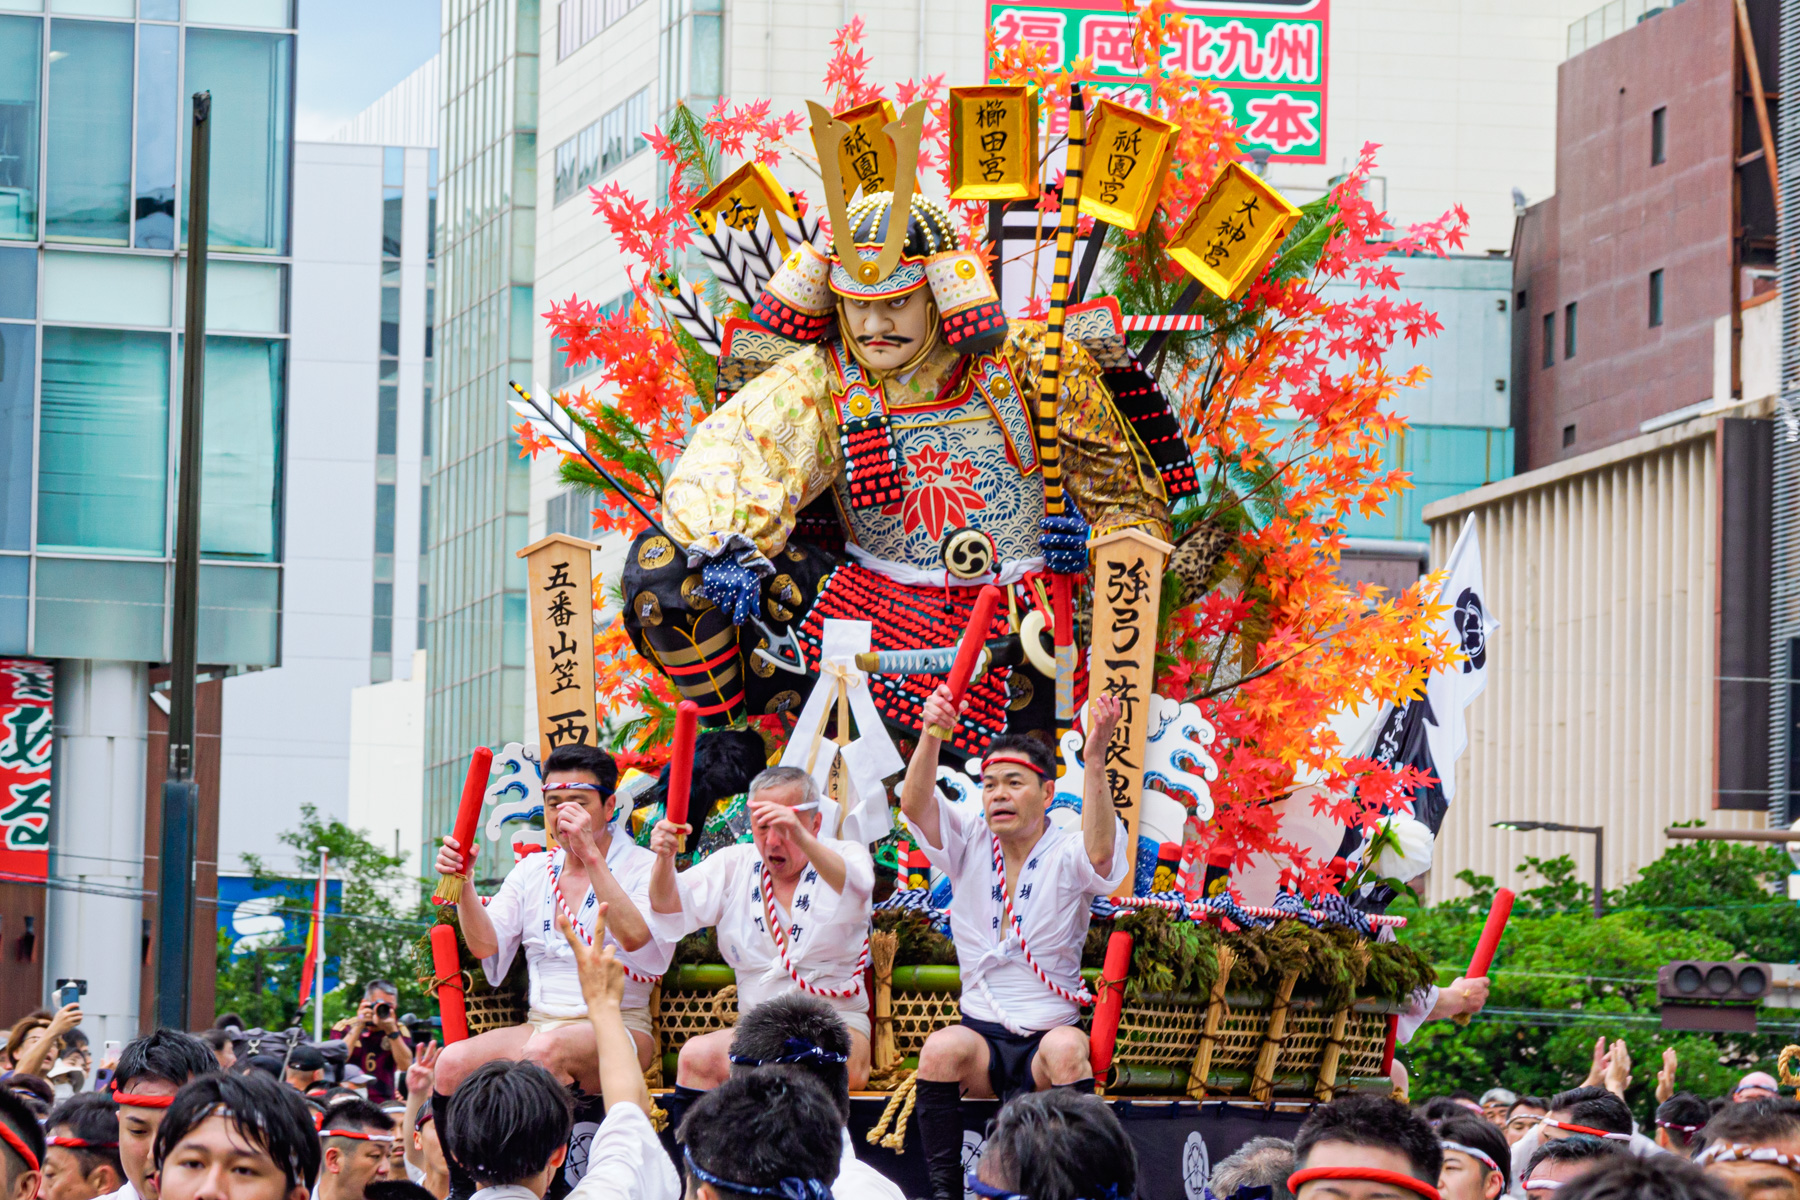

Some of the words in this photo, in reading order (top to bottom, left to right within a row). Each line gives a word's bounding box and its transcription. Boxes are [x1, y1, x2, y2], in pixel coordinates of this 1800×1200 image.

[1166, 23, 1316, 79] 北九州
[975, 99, 1008, 183] 櫛田宮
[1099, 126, 1142, 205] 祇園宮
[1203, 195, 1260, 268] 大神宮
[364, 1051, 377, 1072] 6
